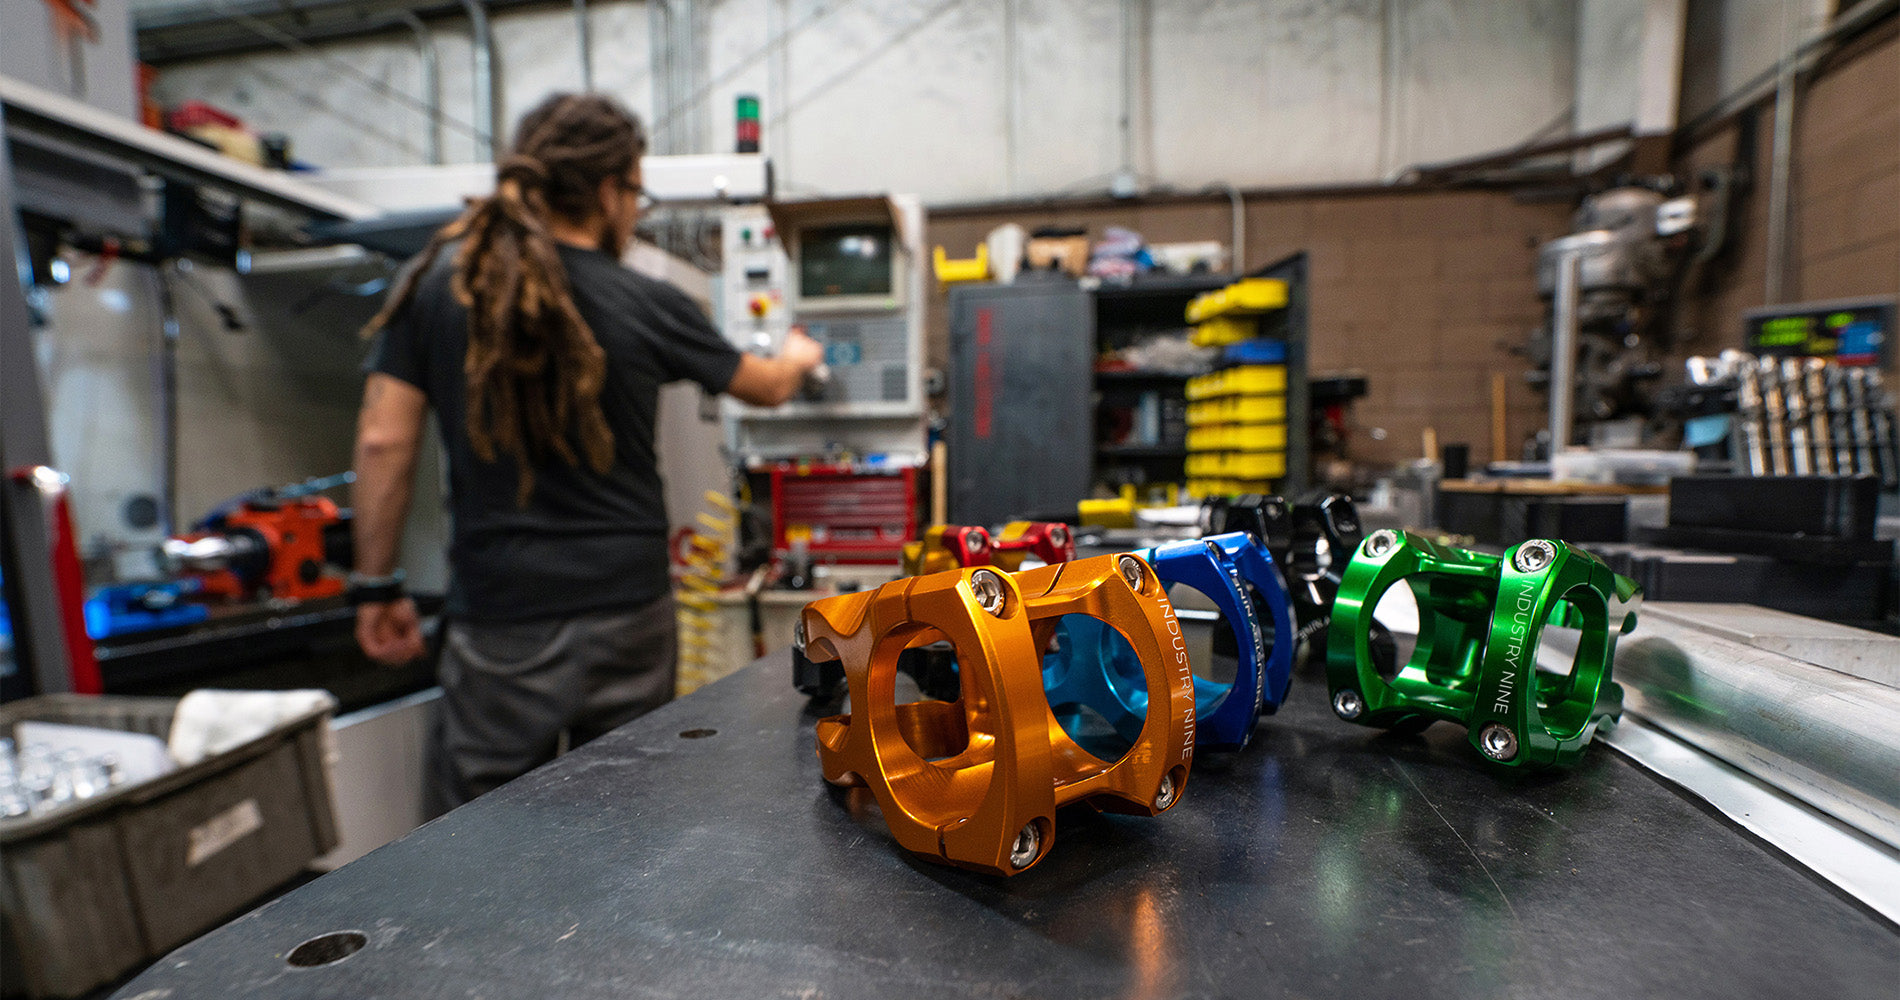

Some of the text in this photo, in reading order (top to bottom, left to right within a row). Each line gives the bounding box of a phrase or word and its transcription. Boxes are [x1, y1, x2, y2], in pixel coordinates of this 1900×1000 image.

[1504, 579, 1536, 669] INDUSTRY
[1157, 598, 1194, 760] INDUSTRY NINE
[1493, 670, 1516, 715] NINE
